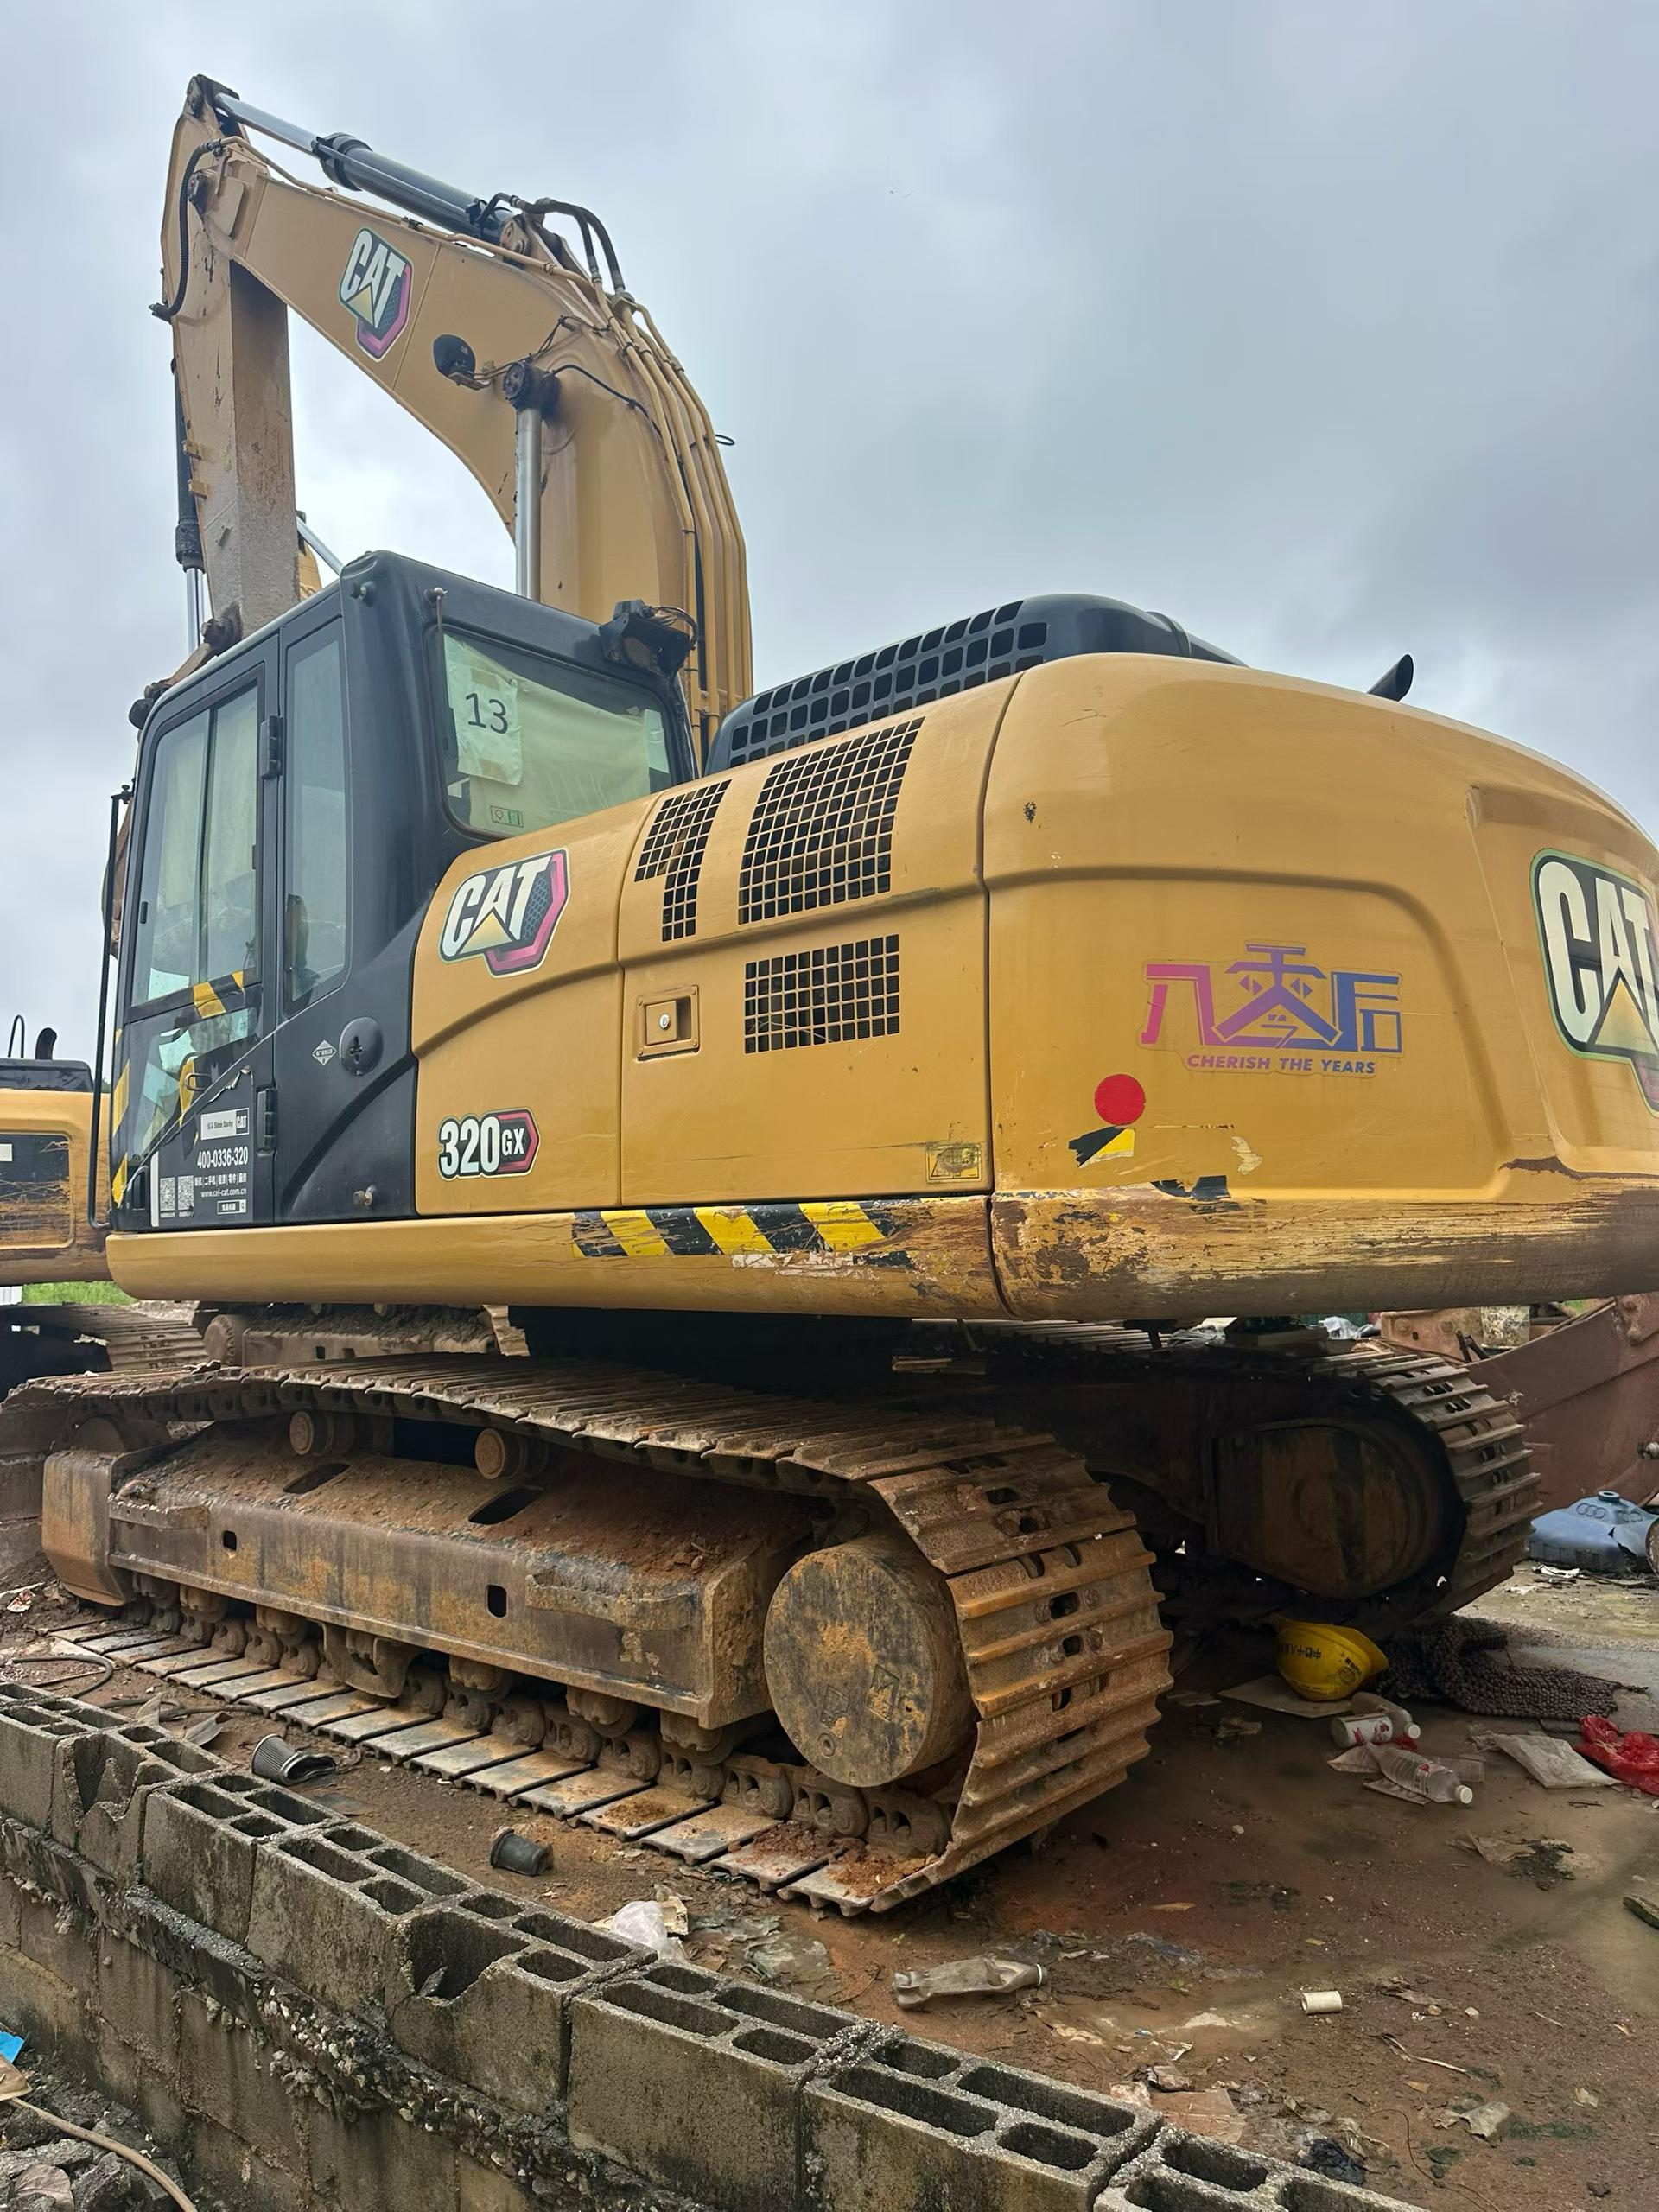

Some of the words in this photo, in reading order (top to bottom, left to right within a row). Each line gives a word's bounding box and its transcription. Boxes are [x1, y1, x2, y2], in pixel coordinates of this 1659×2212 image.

[340, 230, 406, 329] CAT
[465, 692, 508, 734] 13
[442, 855, 552, 957] CAT
[1538, 861, 1659, 1051] CAT
[1186, 1053, 1271, 1071] CHERISH
[1279, 1057, 1313, 1072] THE
[1320, 1058, 1376, 1075] YEARS
[236, 1115, 247, 1129] CAT
[196, 1146, 248, 1169] 400-0336-320
